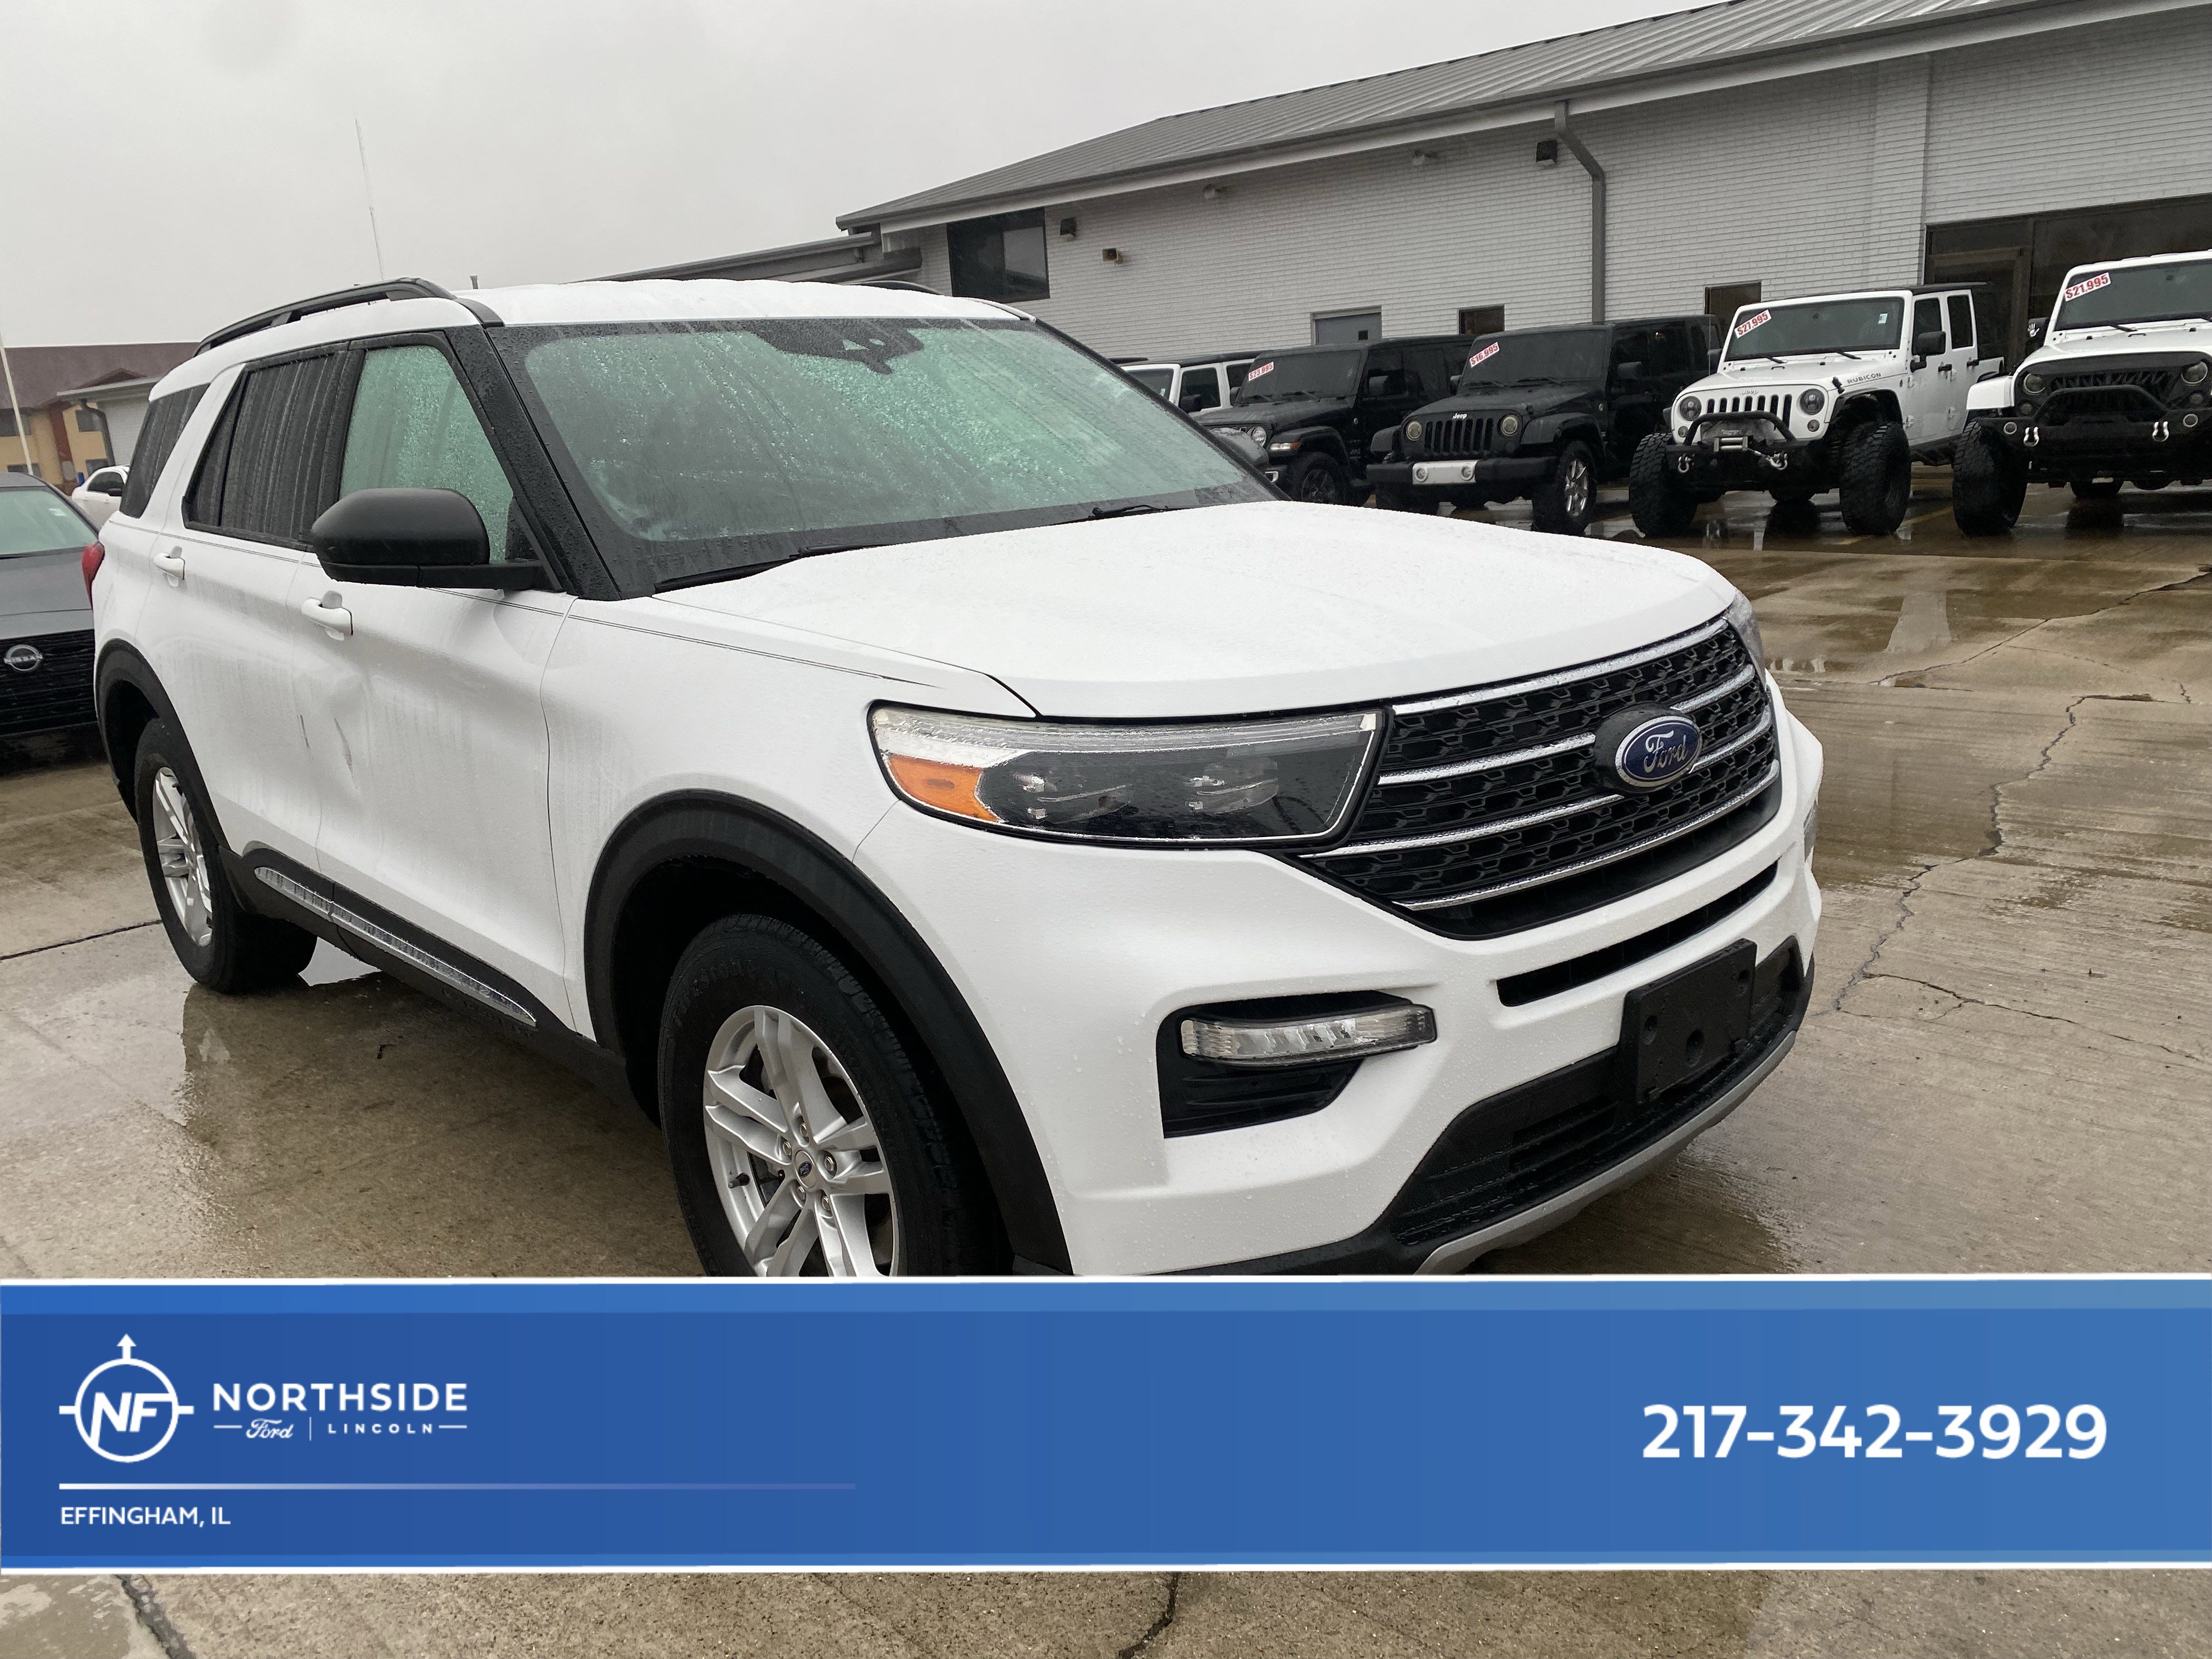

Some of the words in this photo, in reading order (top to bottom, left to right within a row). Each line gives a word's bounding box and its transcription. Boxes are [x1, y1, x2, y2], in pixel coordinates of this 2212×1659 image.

[1847, 373, 1881, 383] RUBICON
[3, 654, 43, 664] NISSAN
[1644, 730, 1688, 773] Ford
